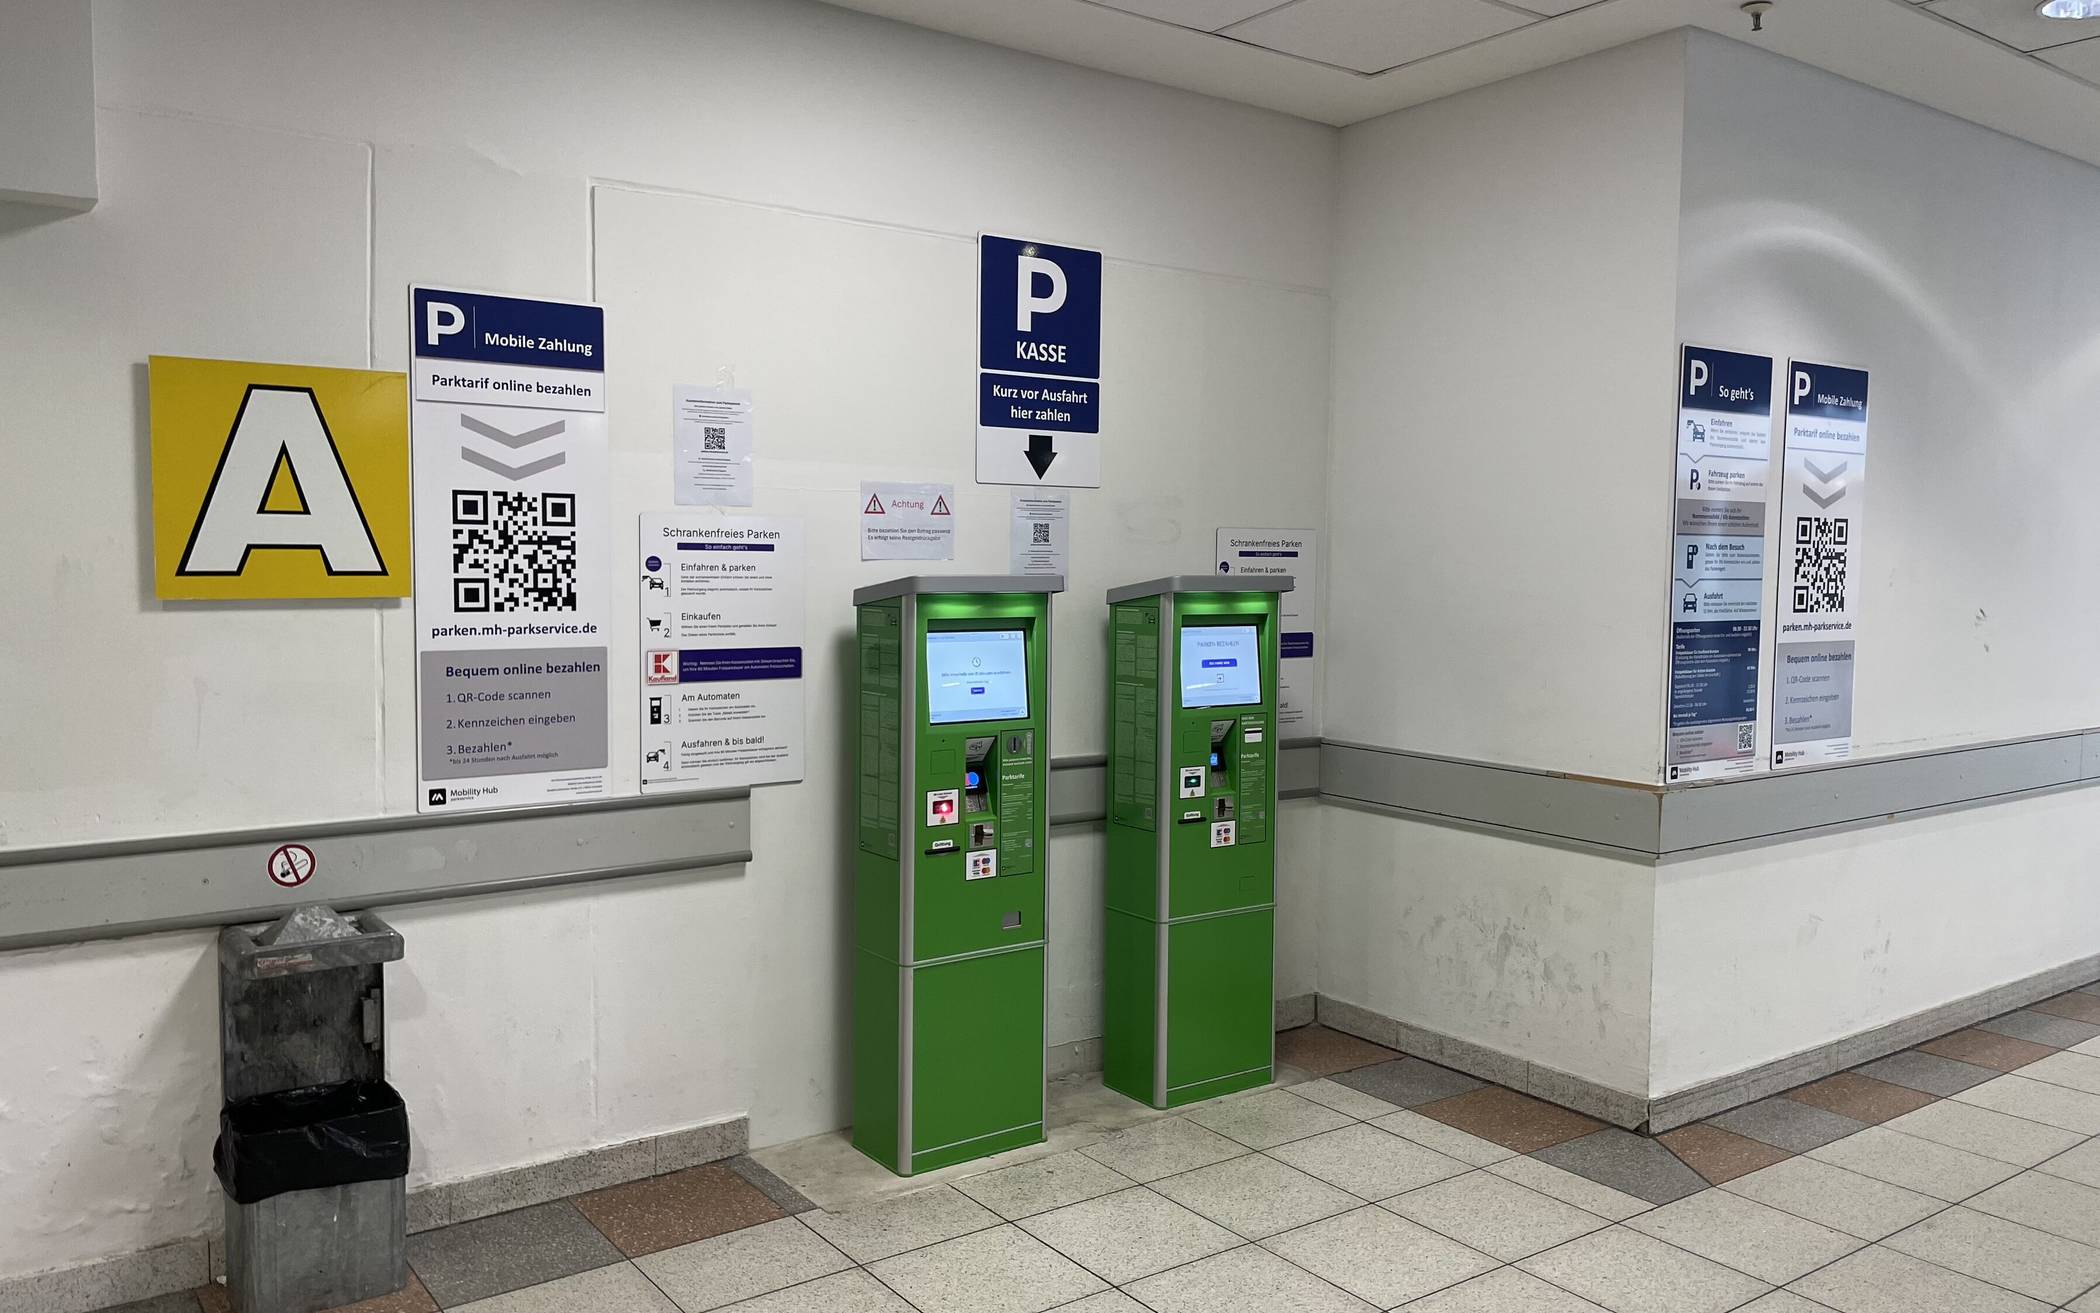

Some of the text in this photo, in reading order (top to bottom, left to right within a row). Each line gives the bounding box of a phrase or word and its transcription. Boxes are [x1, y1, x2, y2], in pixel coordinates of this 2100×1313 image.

[1016, 254, 1068, 333] P
[427, 301, 593, 357] P Mobile Zahlung
[1016, 340, 1067, 364] KASSE
[1689, 359, 1709, 396] P
[1719, 385, 1729, 398] So
[432, 374, 592, 397] Parktarif online bezahlen
[1794, 371, 1863, 410] P Mobile Zahlung
[993, 384, 1088, 404] Kurz vor Ausfahrt
[1010, 405, 1071, 422] hier zahlen
[1711, 418, 1733, 427] Einfahren
[1794, 427, 1860, 442] Parktarif online bezahlen
[175, 383, 390, 577] A
[891, 499, 925, 511] Achtung
[663, 527, 781, 540] Schrankenfreies Parken
[1230, 539, 1303, 549] Schrankenfreies Parken
[681, 563, 756, 573] Einfahren & parken
[1240, 566, 1264, 574] Einfahren
[1270, 566, 1287, 575] parken
[664, 587, 670, 597] 1
[681, 613, 721, 621] Einkaufen
[431, 622, 598, 640] parken.mh-parkservice.de
[664, 628, 670, 639] 2
[1783, 621, 1852, 634] parken.mh-parkservice.de
[1787, 651, 1852, 664] Bequem online bezahlen
[446, 661, 601, 679] Bequem online bezahlen
[648, 675, 677, 683] Kaufland
[447, 690, 551, 703] 1. QR-Code scannen
[698, 693, 740, 701] Automaten
[446, 713, 576, 729] 2. Kennzeichen eingeben
[664, 715, 670, 724] 3
[681, 736, 765, 749] Ausfahren & bis bald!
[447, 745, 456, 755] 3.
[663, 762, 670, 771] 4
[450, 787, 499, 798] Mobility Hub
